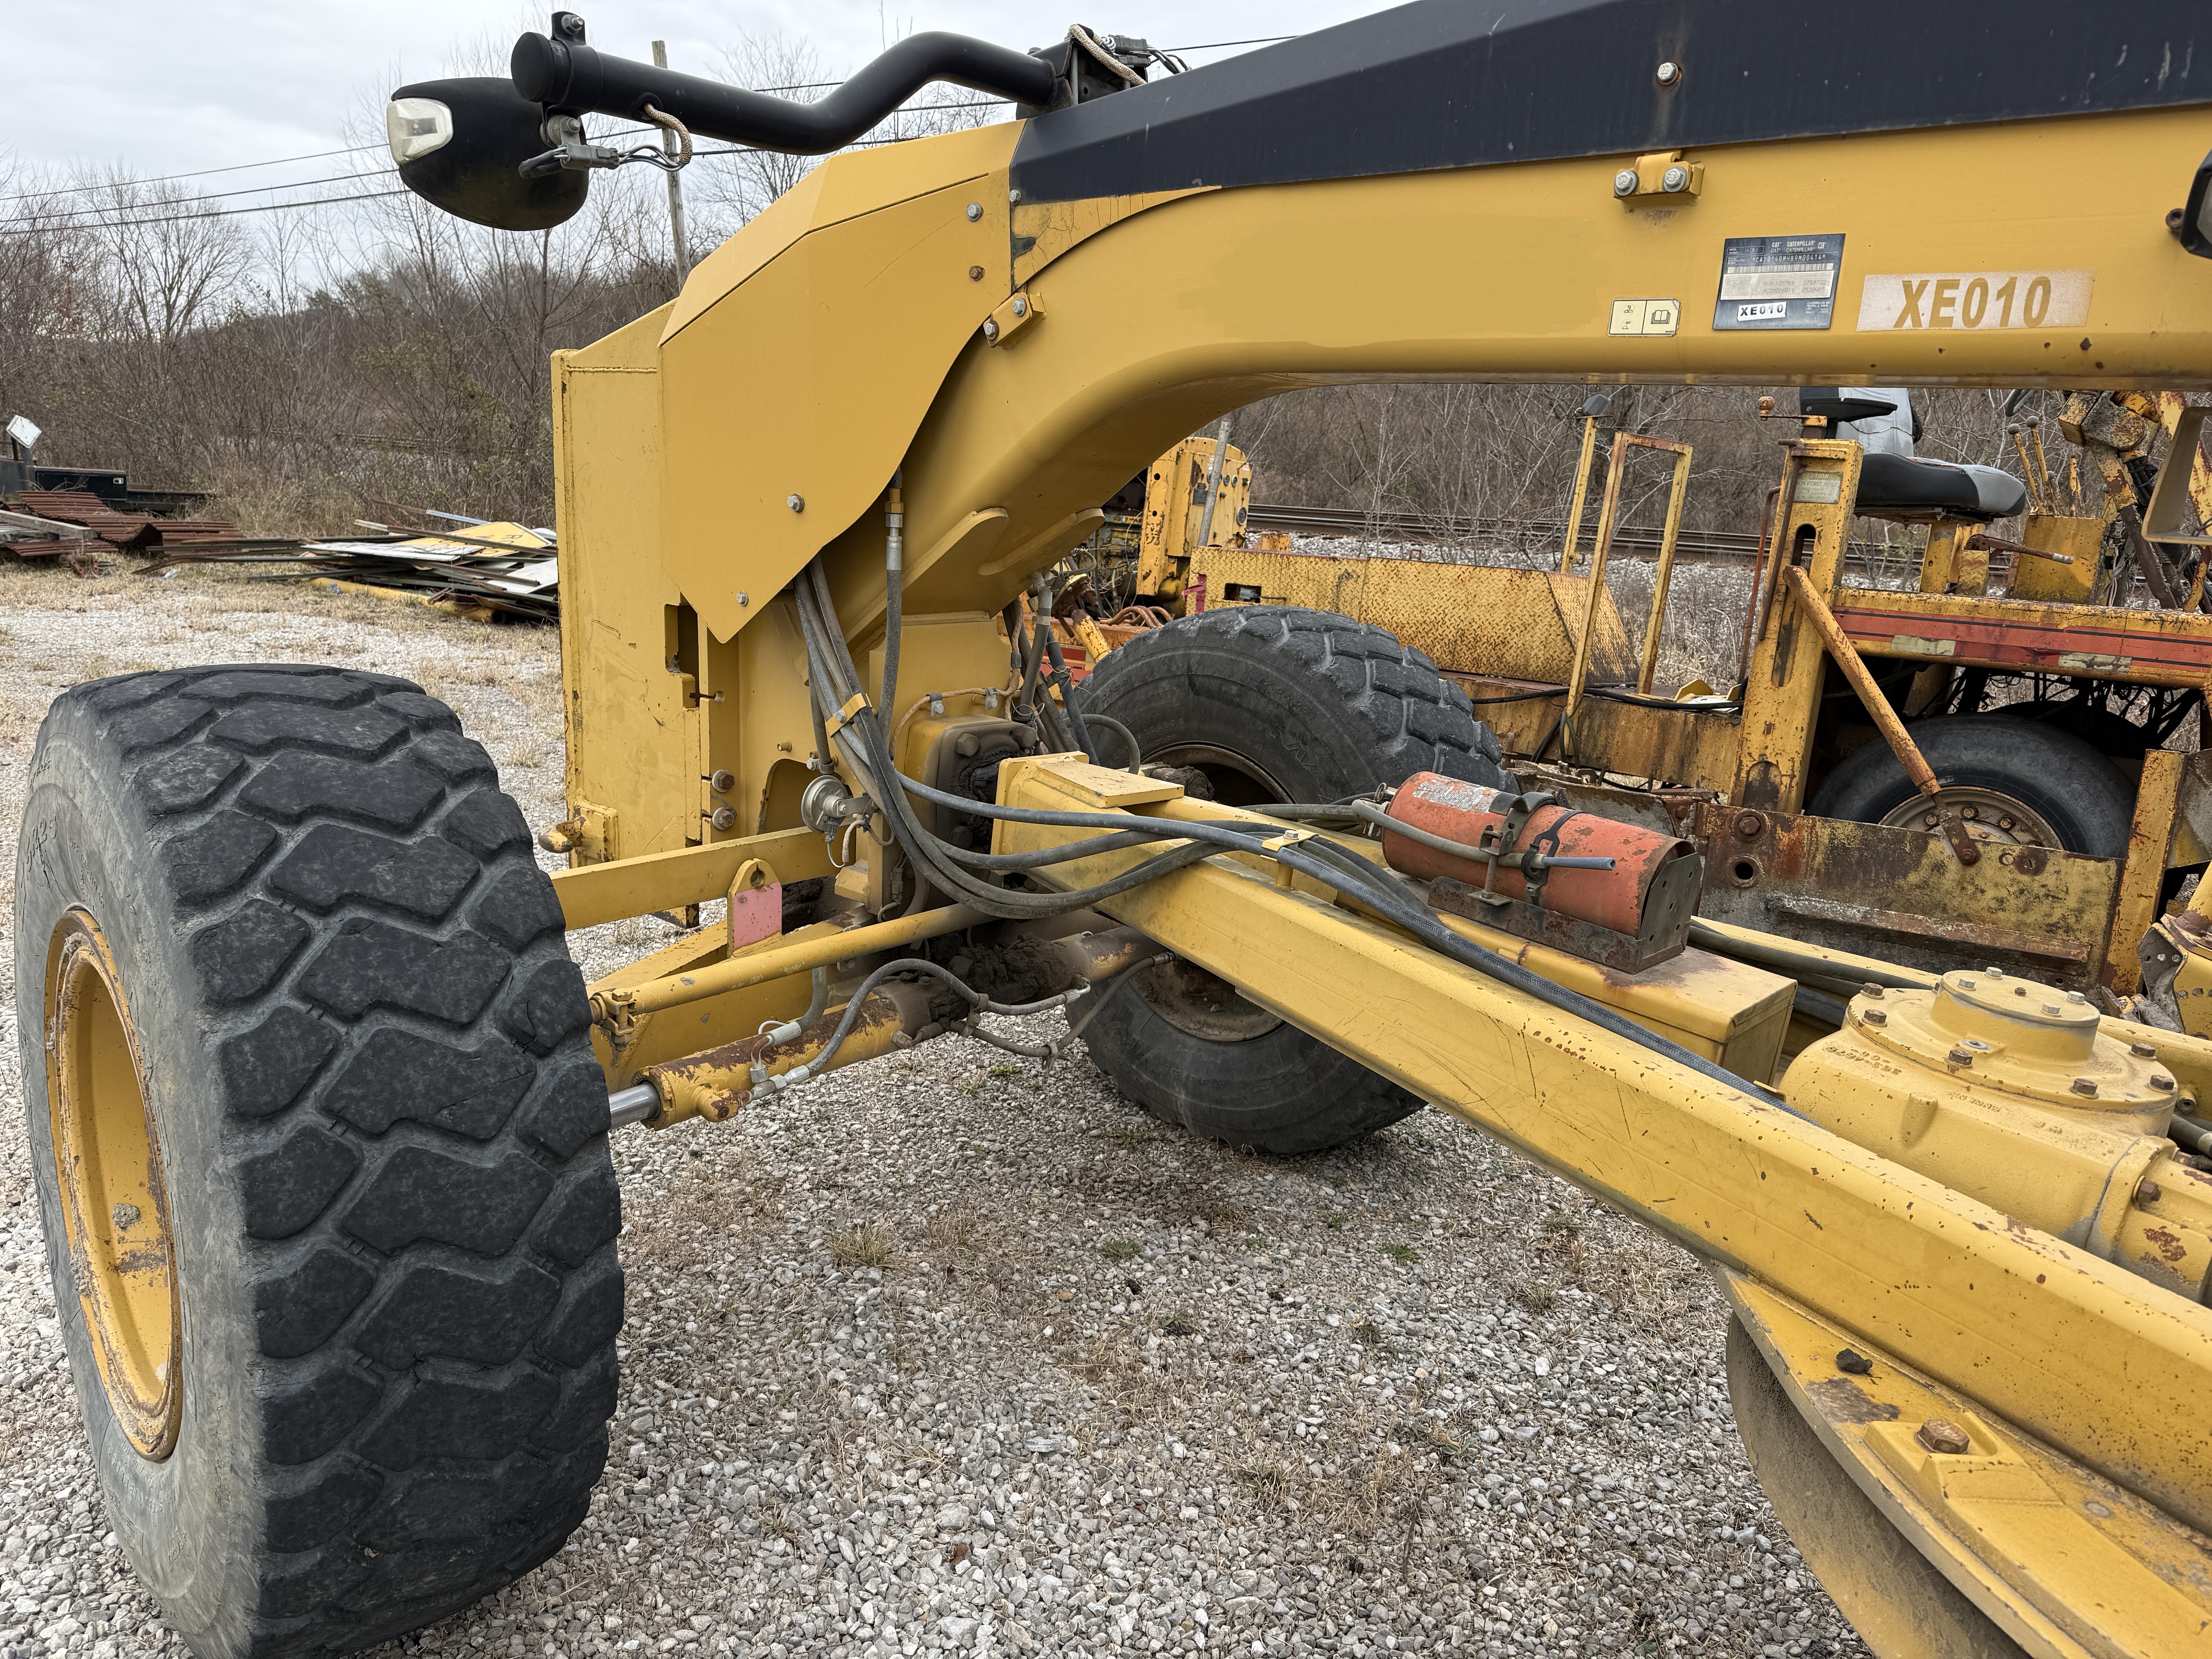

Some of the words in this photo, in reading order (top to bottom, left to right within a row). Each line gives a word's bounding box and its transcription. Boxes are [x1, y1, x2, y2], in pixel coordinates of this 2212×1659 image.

[1740, 304, 1783, 316] XE010
[1893, 276, 2051, 328] XE010
[1137, 718, 1185, 740] UBELESS
